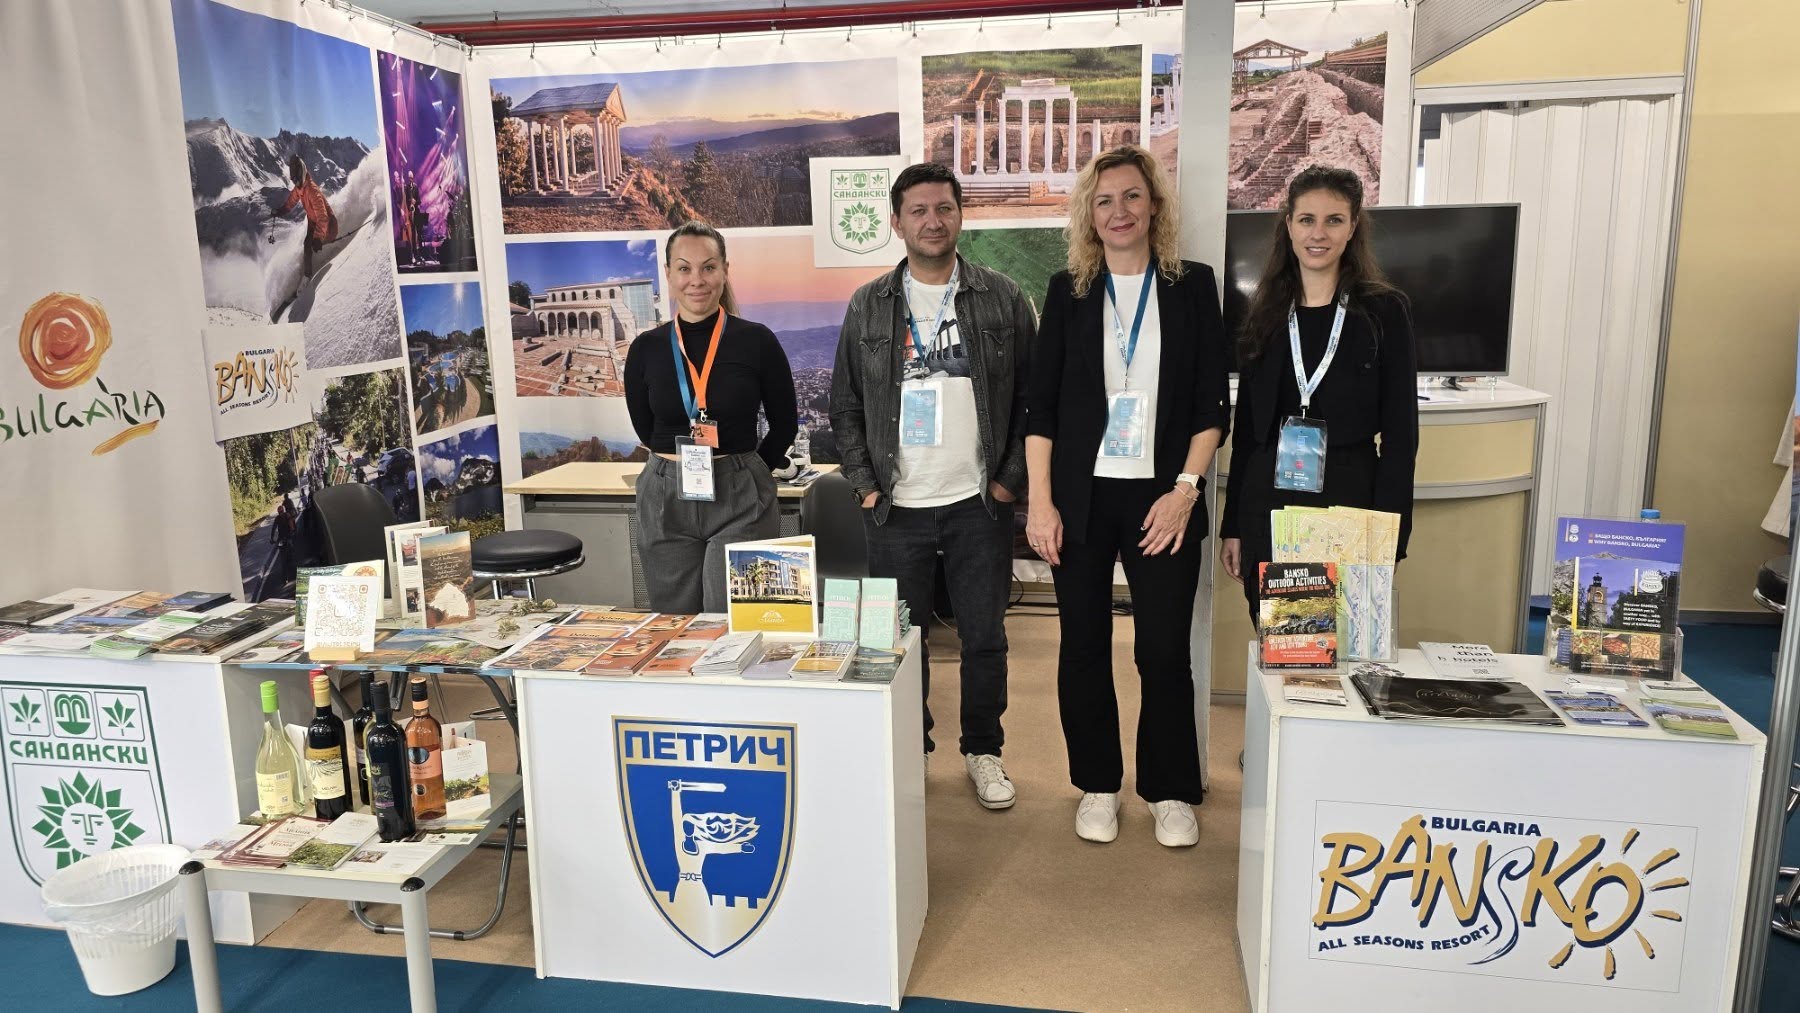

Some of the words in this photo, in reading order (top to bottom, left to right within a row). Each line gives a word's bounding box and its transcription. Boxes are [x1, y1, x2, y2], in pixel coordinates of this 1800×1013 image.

[833, 190, 887, 199] САНДАНСКИ
[245, 348, 275, 356] BULGARIA
[214, 350, 293, 408] BANSKO
[220, 407, 229, 415] ALL
[229, 401, 251, 410] SEASONS
[252, 391, 271, 405] RESORT
[1268, 578, 1295, 589] OUTDOOR
[1295, 575, 1327, 587] ACTIVITIES
[1283, 567, 1309, 579] BANSKO
[9, 740, 148, 765] САНДАНСКИ
[624, 730, 786, 766] ПЕТРИЧ
[1431, 816, 1542, 837] BULGARIA
[1312, 813, 1645, 965] BANSKO
[1318, 938, 1347, 951] ALL
[1353, 935, 1424, 950] SEASONS
[1431, 925, 1490, 950] RESORT
